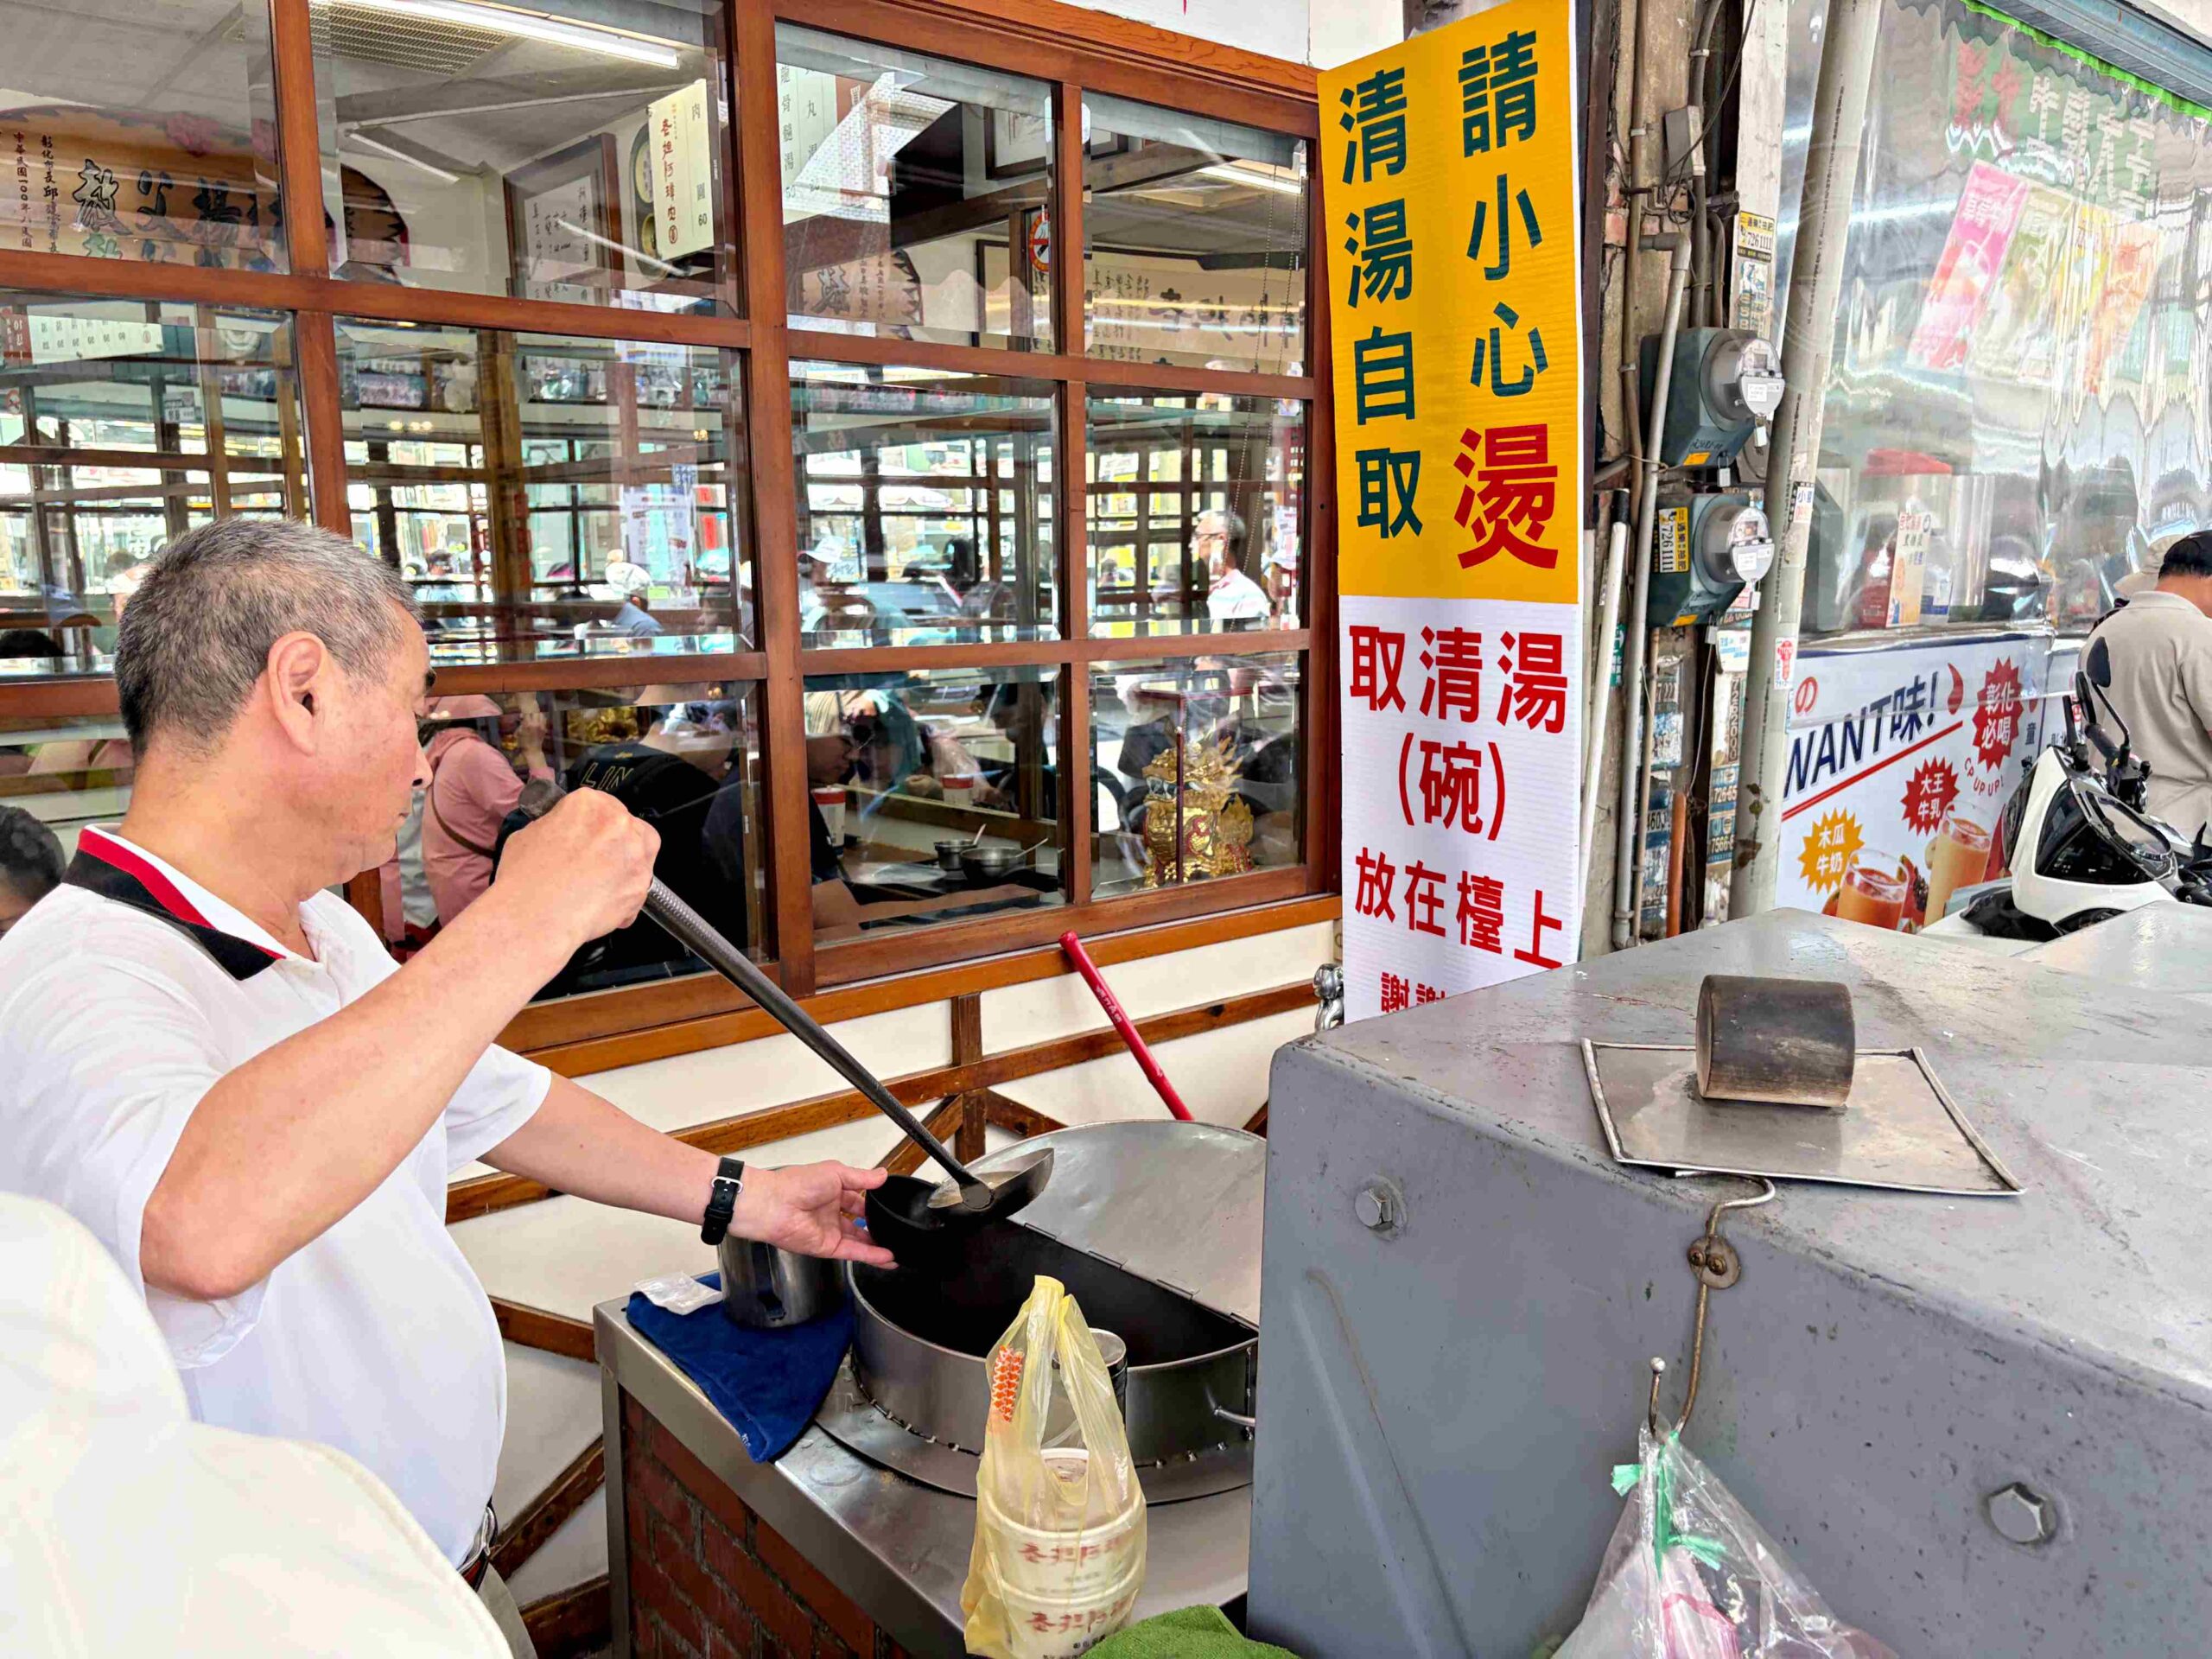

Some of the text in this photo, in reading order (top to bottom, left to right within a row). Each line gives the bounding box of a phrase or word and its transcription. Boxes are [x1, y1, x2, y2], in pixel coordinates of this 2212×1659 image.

[698, 213, 708, 226] 60
[1339, 67, 1423, 539] 清湯自取
[1453, 29, 1559, 569] 請小心燙
[1661, 525, 1674, 572] 7261111
[1349, 625, 1568, 734] 取清湯
[1795, 677, 1819, 715] の
[1985, 681, 2016, 715] 彰化
[1981, 715, 2012, 749] 必喝
[1398, 732, 1506, 841] (碗)
[1921, 772, 1945, 795] 大王
[1974, 778, 1986, 795] UP
[1987, 774, 2005, 798] UP!
[1917, 798, 1942, 821] 牛乳
[1819, 823, 1845, 849] 木瓜
[1816, 851, 1844, 876] 牛奶
[1355, 847, 1563, 969] 放在檯上
